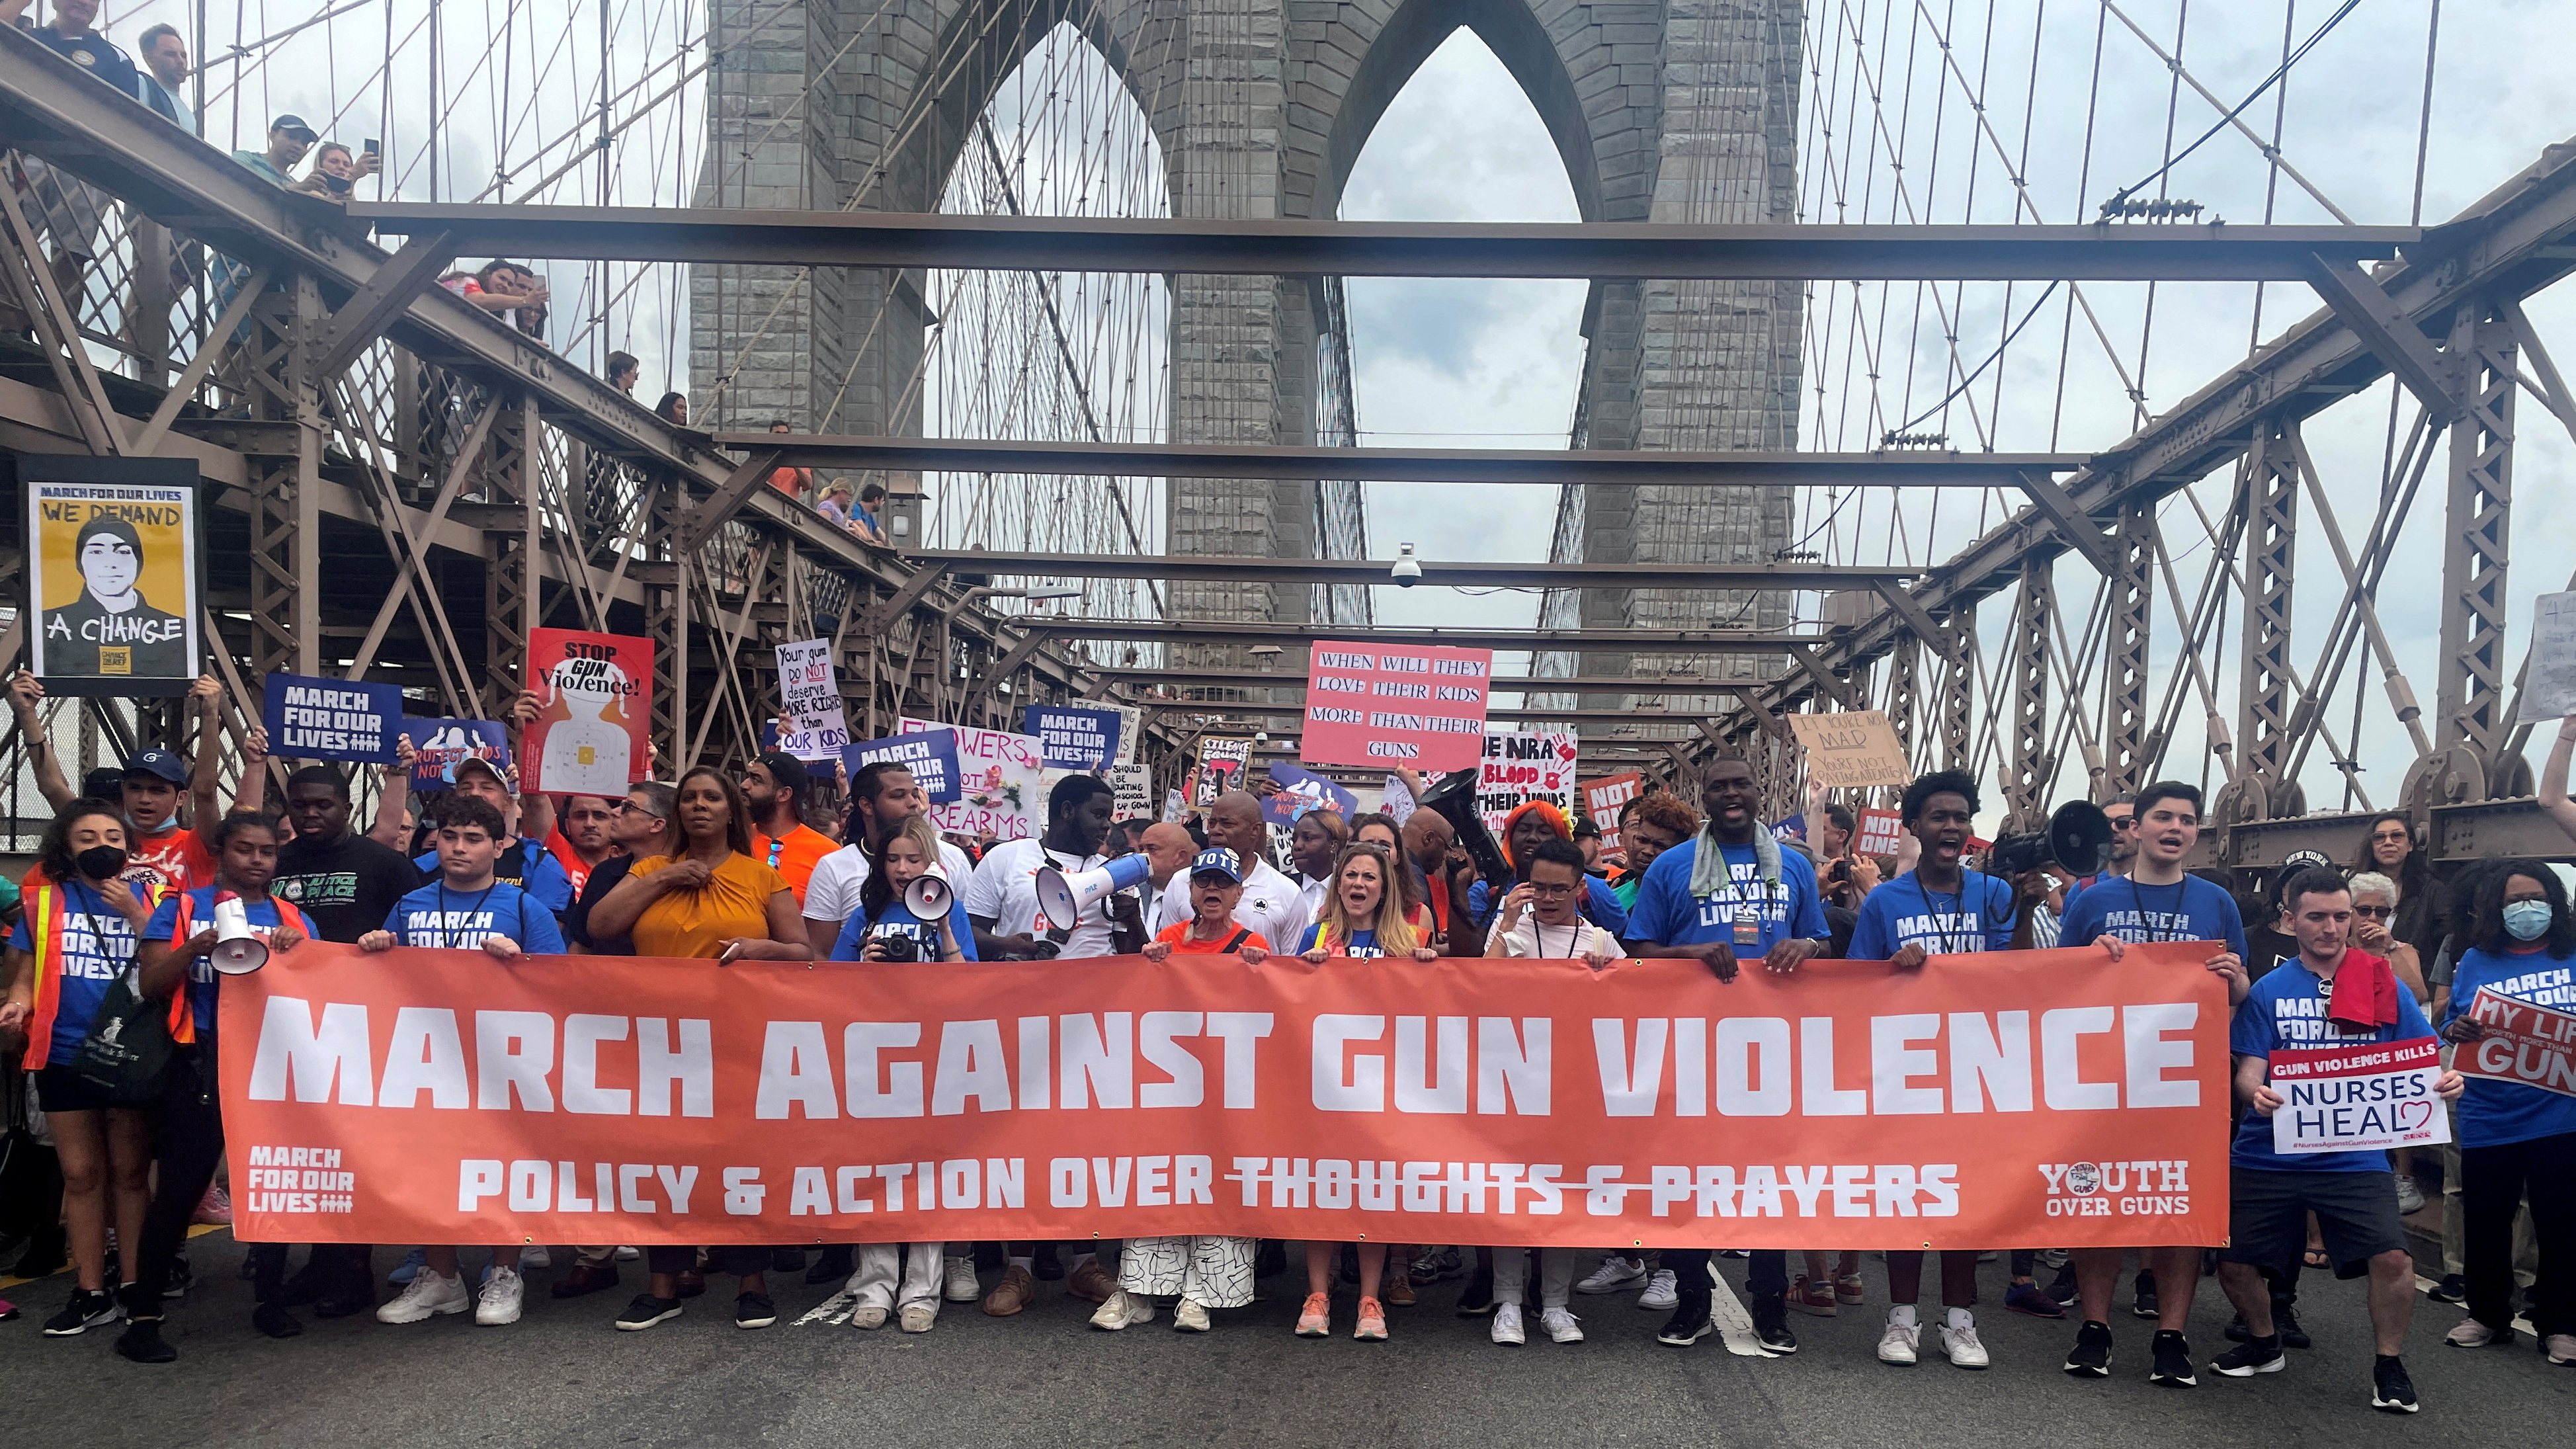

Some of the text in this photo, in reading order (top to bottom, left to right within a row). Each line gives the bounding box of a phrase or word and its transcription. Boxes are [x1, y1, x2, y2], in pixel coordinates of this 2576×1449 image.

[40, 487, 181, 501] MARCH FOR OUR LIVES
[42, 502, 180, 526] WE DEMAND
[46, 613, 183, 644] A CHANGE
[565, 642, 616, 661] STOP
[778, 647, 804, 666] Your
[571, 660, 608, 677] GUN
[789, 663, 826, 682] DO NOT
[1321, 653, 1484, 676] WHEN WILL THEY
[538, 667, 640, 696] Violence!
[788, 684, 825, 699] deserve
[1318, 677, 1480, 702] LOVE THEIR KIDS
[285, 686, 369, 711] MARCH
[784, 694, 841, 717] MORE RIGHTS
[284, 706, 382, 733] FOR OUR
[801, 716, 823, 729] than
[1040, 714, 1097, 732] MARCH
[1311, 707, 1480, 734] MORE THAN THEIR
[284, 727, 348, 750] LIVES
[784, 727, 847, 750] OUR KIDS
[903, 720, 1028, 762] FWERS
[1040, 729, 1106, 748] FOR OUR
[1204, 739, 1251, 753] SILENCE
[1369, 741, 1419, 757] GUNS
[1507, 737, 1554, 760] NRA
[1818, 729, 1867, 748] MAD
[415, 749, 466, 763] ROTECT
[861, 741, 930, 767] MARCH
[1042, 745, 1083, 761] LIVES
[1857, 757, 1889, 770] NOT
[961, 773, 982, 788] OT
[1483, 764, 1539, 784] BLOOD
[1817, 770, 1859, 785] PAYING
[1476, 793, 1520, 811] THEIR
[1589, 780, 1635, 809] NOT
[929, 802, 1028, 838] REARMS
[1595, 806, 1623, 831] ON
[1865, 815, 1903, 836] NOT
[1860, 835, 1900, 855] ONE
[1198, 852, 1239, 875] VOTE
[2286, 850, 2329, 867] NEW YORK
[408, 911, 494, 930] MARCH
[1896, 913, 1978, 938] MARCH
[2105, 911, 2189, 930] MARCH
[62, 932, 97, 955] OR
[61, 955, 116, 979] IVES
[2485, 968, 2571, 995] MARCH
[2276, 1019, 2324, 1040] FOR
[2474, 995, 2576, 1044] MY LIF
[2519, 1036, 2546, 1048] MORE
[2548, 1042, 2573, 1054] THAN
[249, 995, 2200, 1120] MARCH AGAINST GUN VIOLENCE
[2273, 1043, 2436, 1076] GUN VIOLENCE KILLS
[2291, 1073, 2426, 1106] NURSES
[2296, 1104, 2411, 1138] HEAL
[249, 1145, 341, 1168] MARCH
[249, 1169, 354, 1192] FOR OUR
[458, 1155, 1960, 1218] POLICY & ACTION OVER THOUGHTS & PRAYERS
[248, 1192, 317, 1213] LIVES
[2046, 1196, 2190, 1216] OVER GUNS
